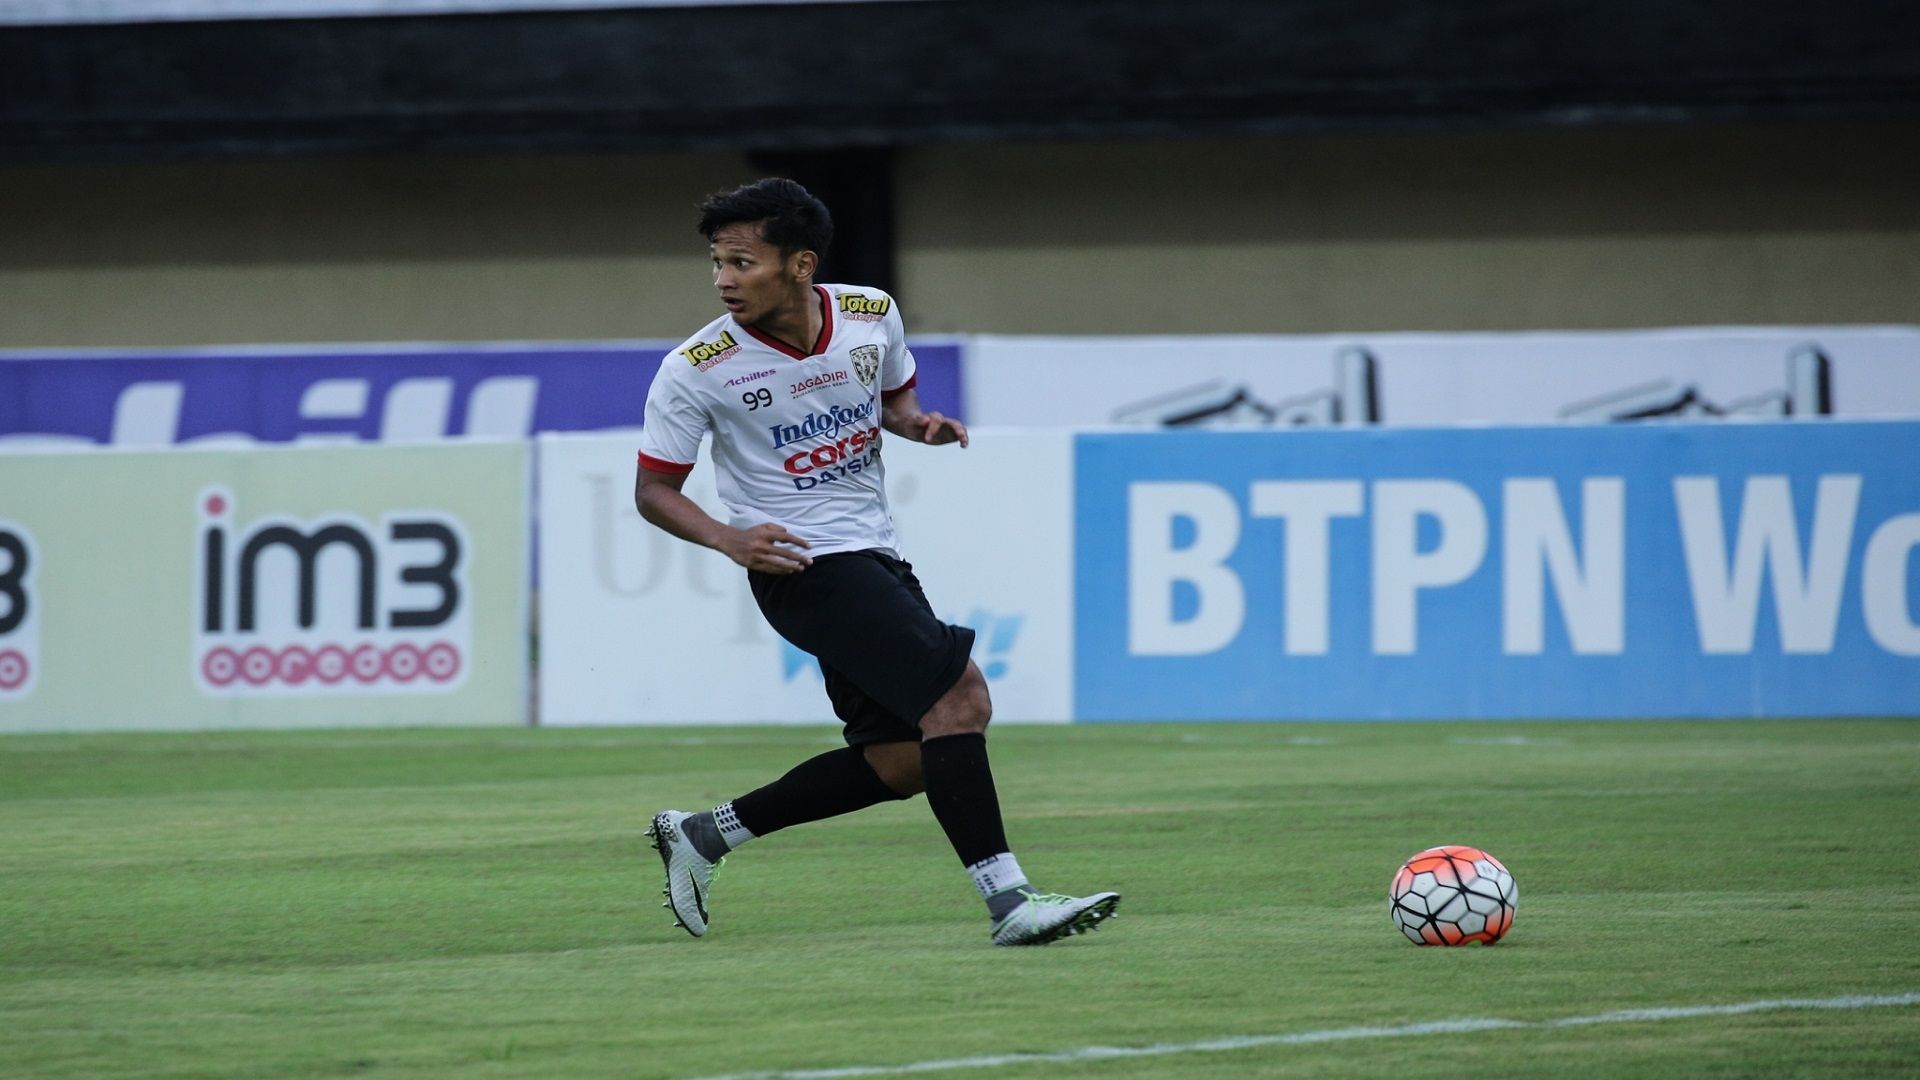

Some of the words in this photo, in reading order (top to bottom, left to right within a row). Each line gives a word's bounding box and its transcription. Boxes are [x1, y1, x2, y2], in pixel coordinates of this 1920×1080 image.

[834, 292, 890, 317] Total
[678, 330, 739, 367] Total
[723, 368, 777, 389] Achilles
[790, 370, 848, 395] JAGADIRI
[742, 388, 773, 412] 99
[769, 395, 875, 450] Indofood
[203, 493, 462, 634] im3
[1129, 477, 1626, 656] BTPN
[1673, 473, 1920, 657] Wo
[202, 641, 463, 688] ooredoo
